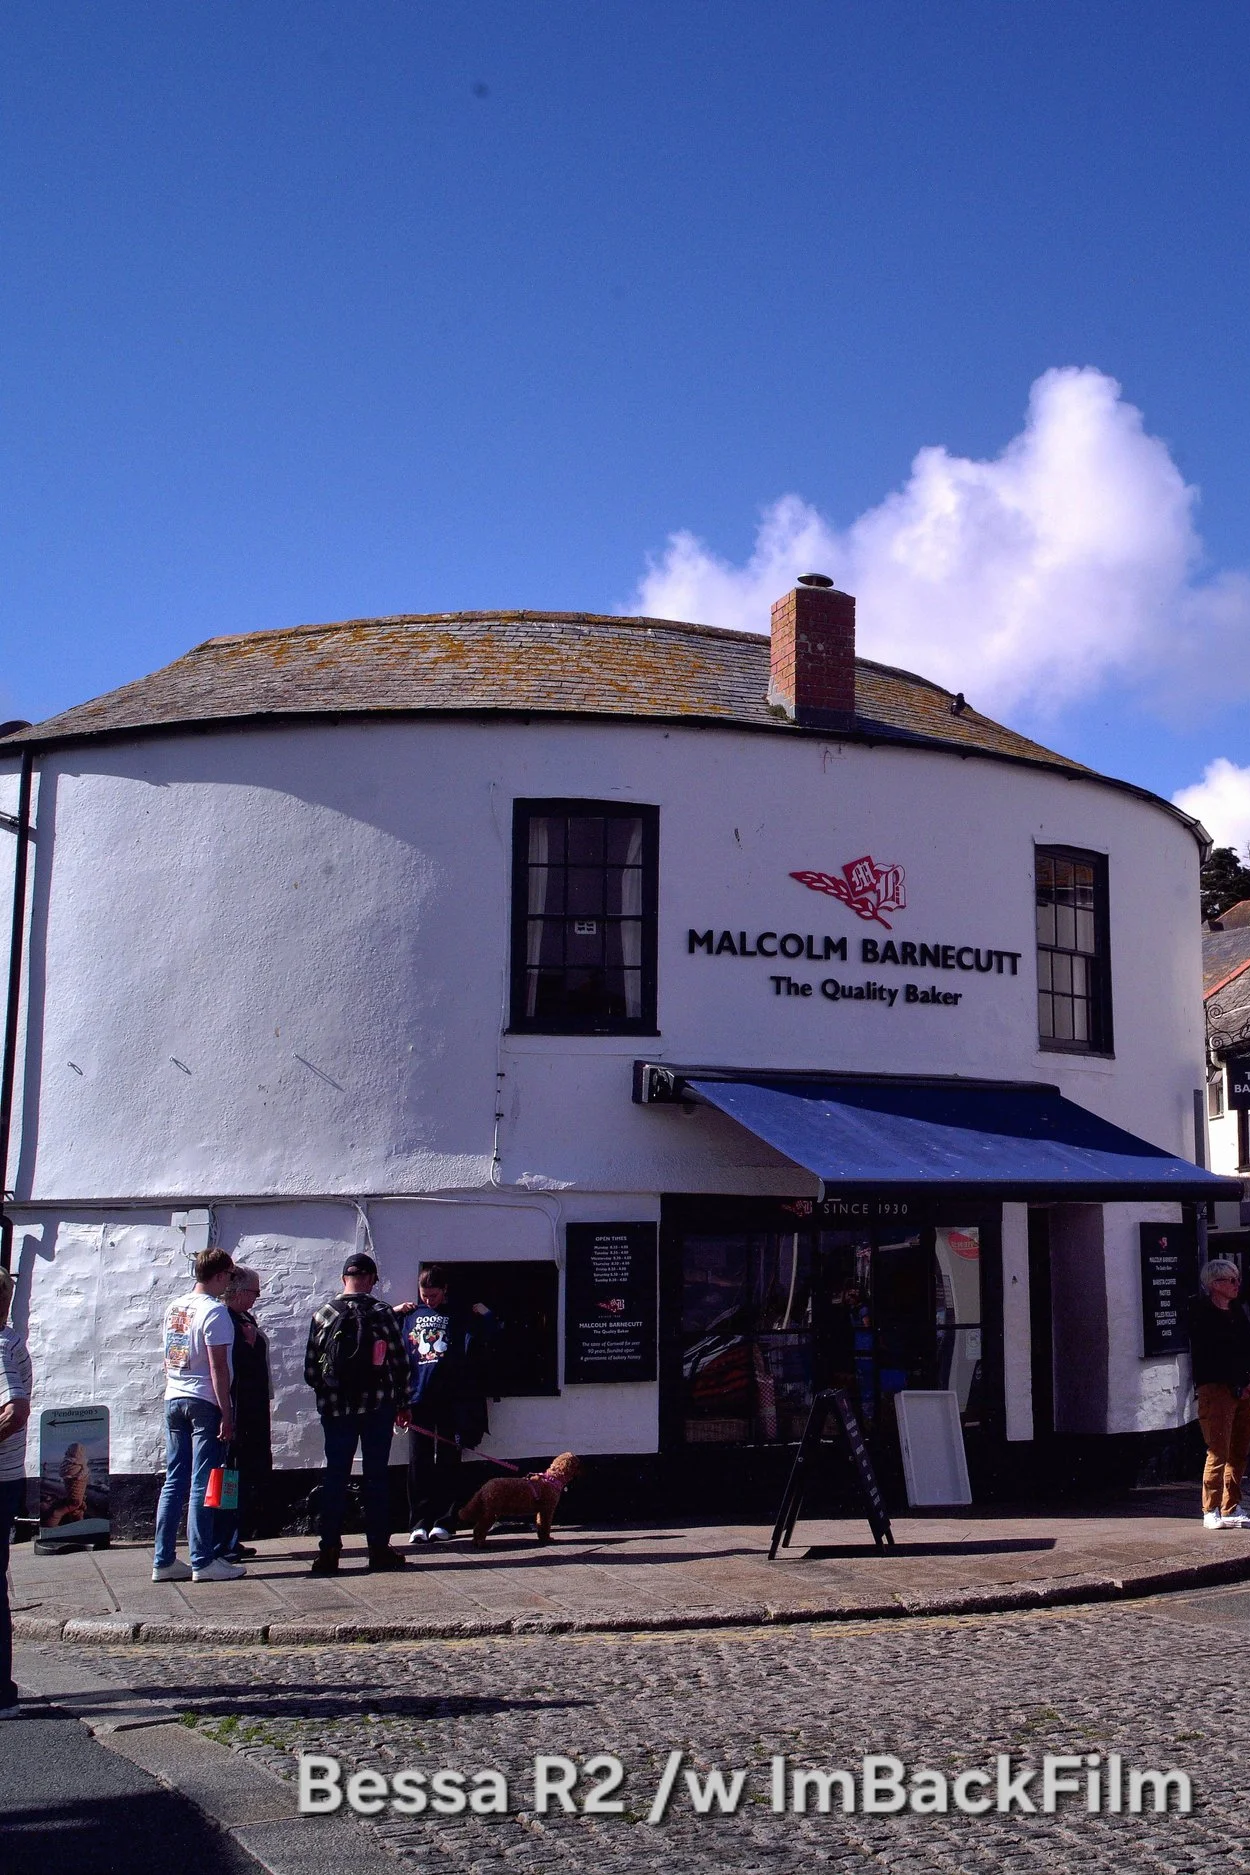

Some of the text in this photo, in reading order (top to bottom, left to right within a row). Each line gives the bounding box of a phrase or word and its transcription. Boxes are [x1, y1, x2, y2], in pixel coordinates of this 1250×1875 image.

[688, 928, 1022, 976] MALCOLM BARNECUTT
[770, 976, 962, 1007] The Quality Baker
[824, 1204, 908, 1214] SINCE 1930
[416, 1316, 449, 1325] GOOSE
